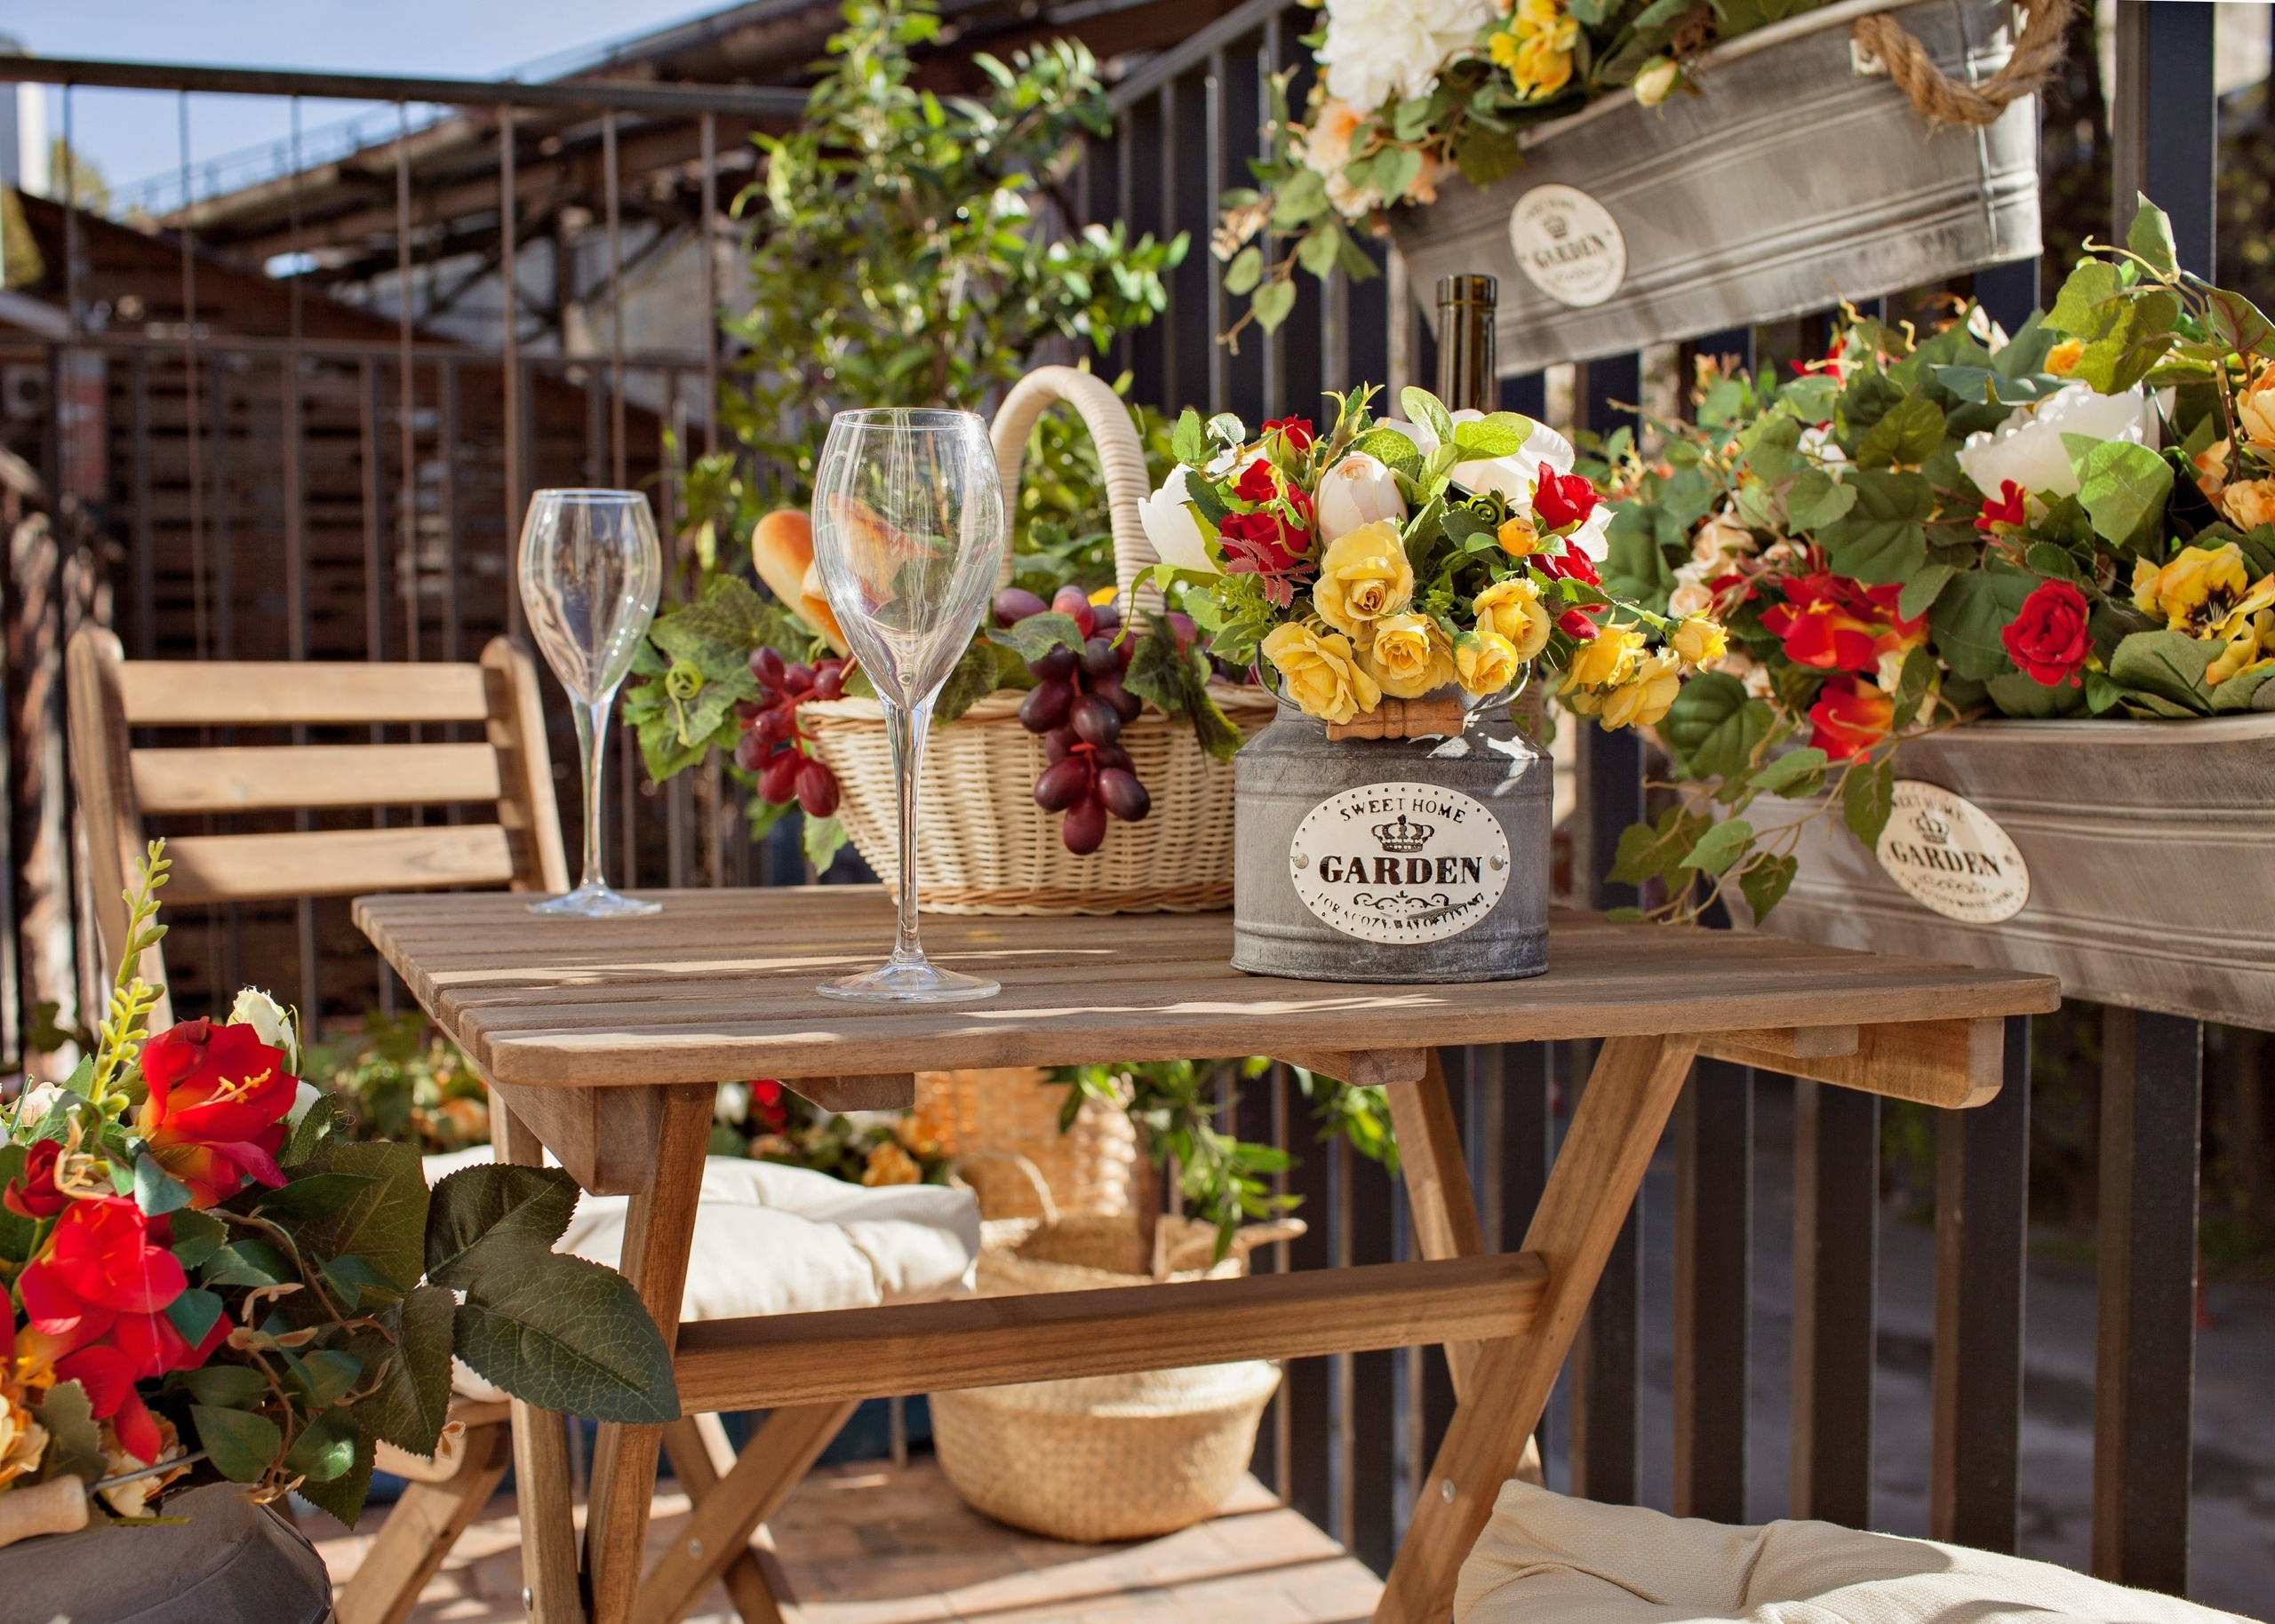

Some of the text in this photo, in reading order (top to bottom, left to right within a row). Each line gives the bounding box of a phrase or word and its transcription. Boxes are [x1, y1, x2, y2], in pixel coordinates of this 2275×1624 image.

[1339, 798, 1466, 824] SWEET HOME
[1319, 855, 1483, 885] GARDEN
[1889, 839, 2002, 878] GARDEN
